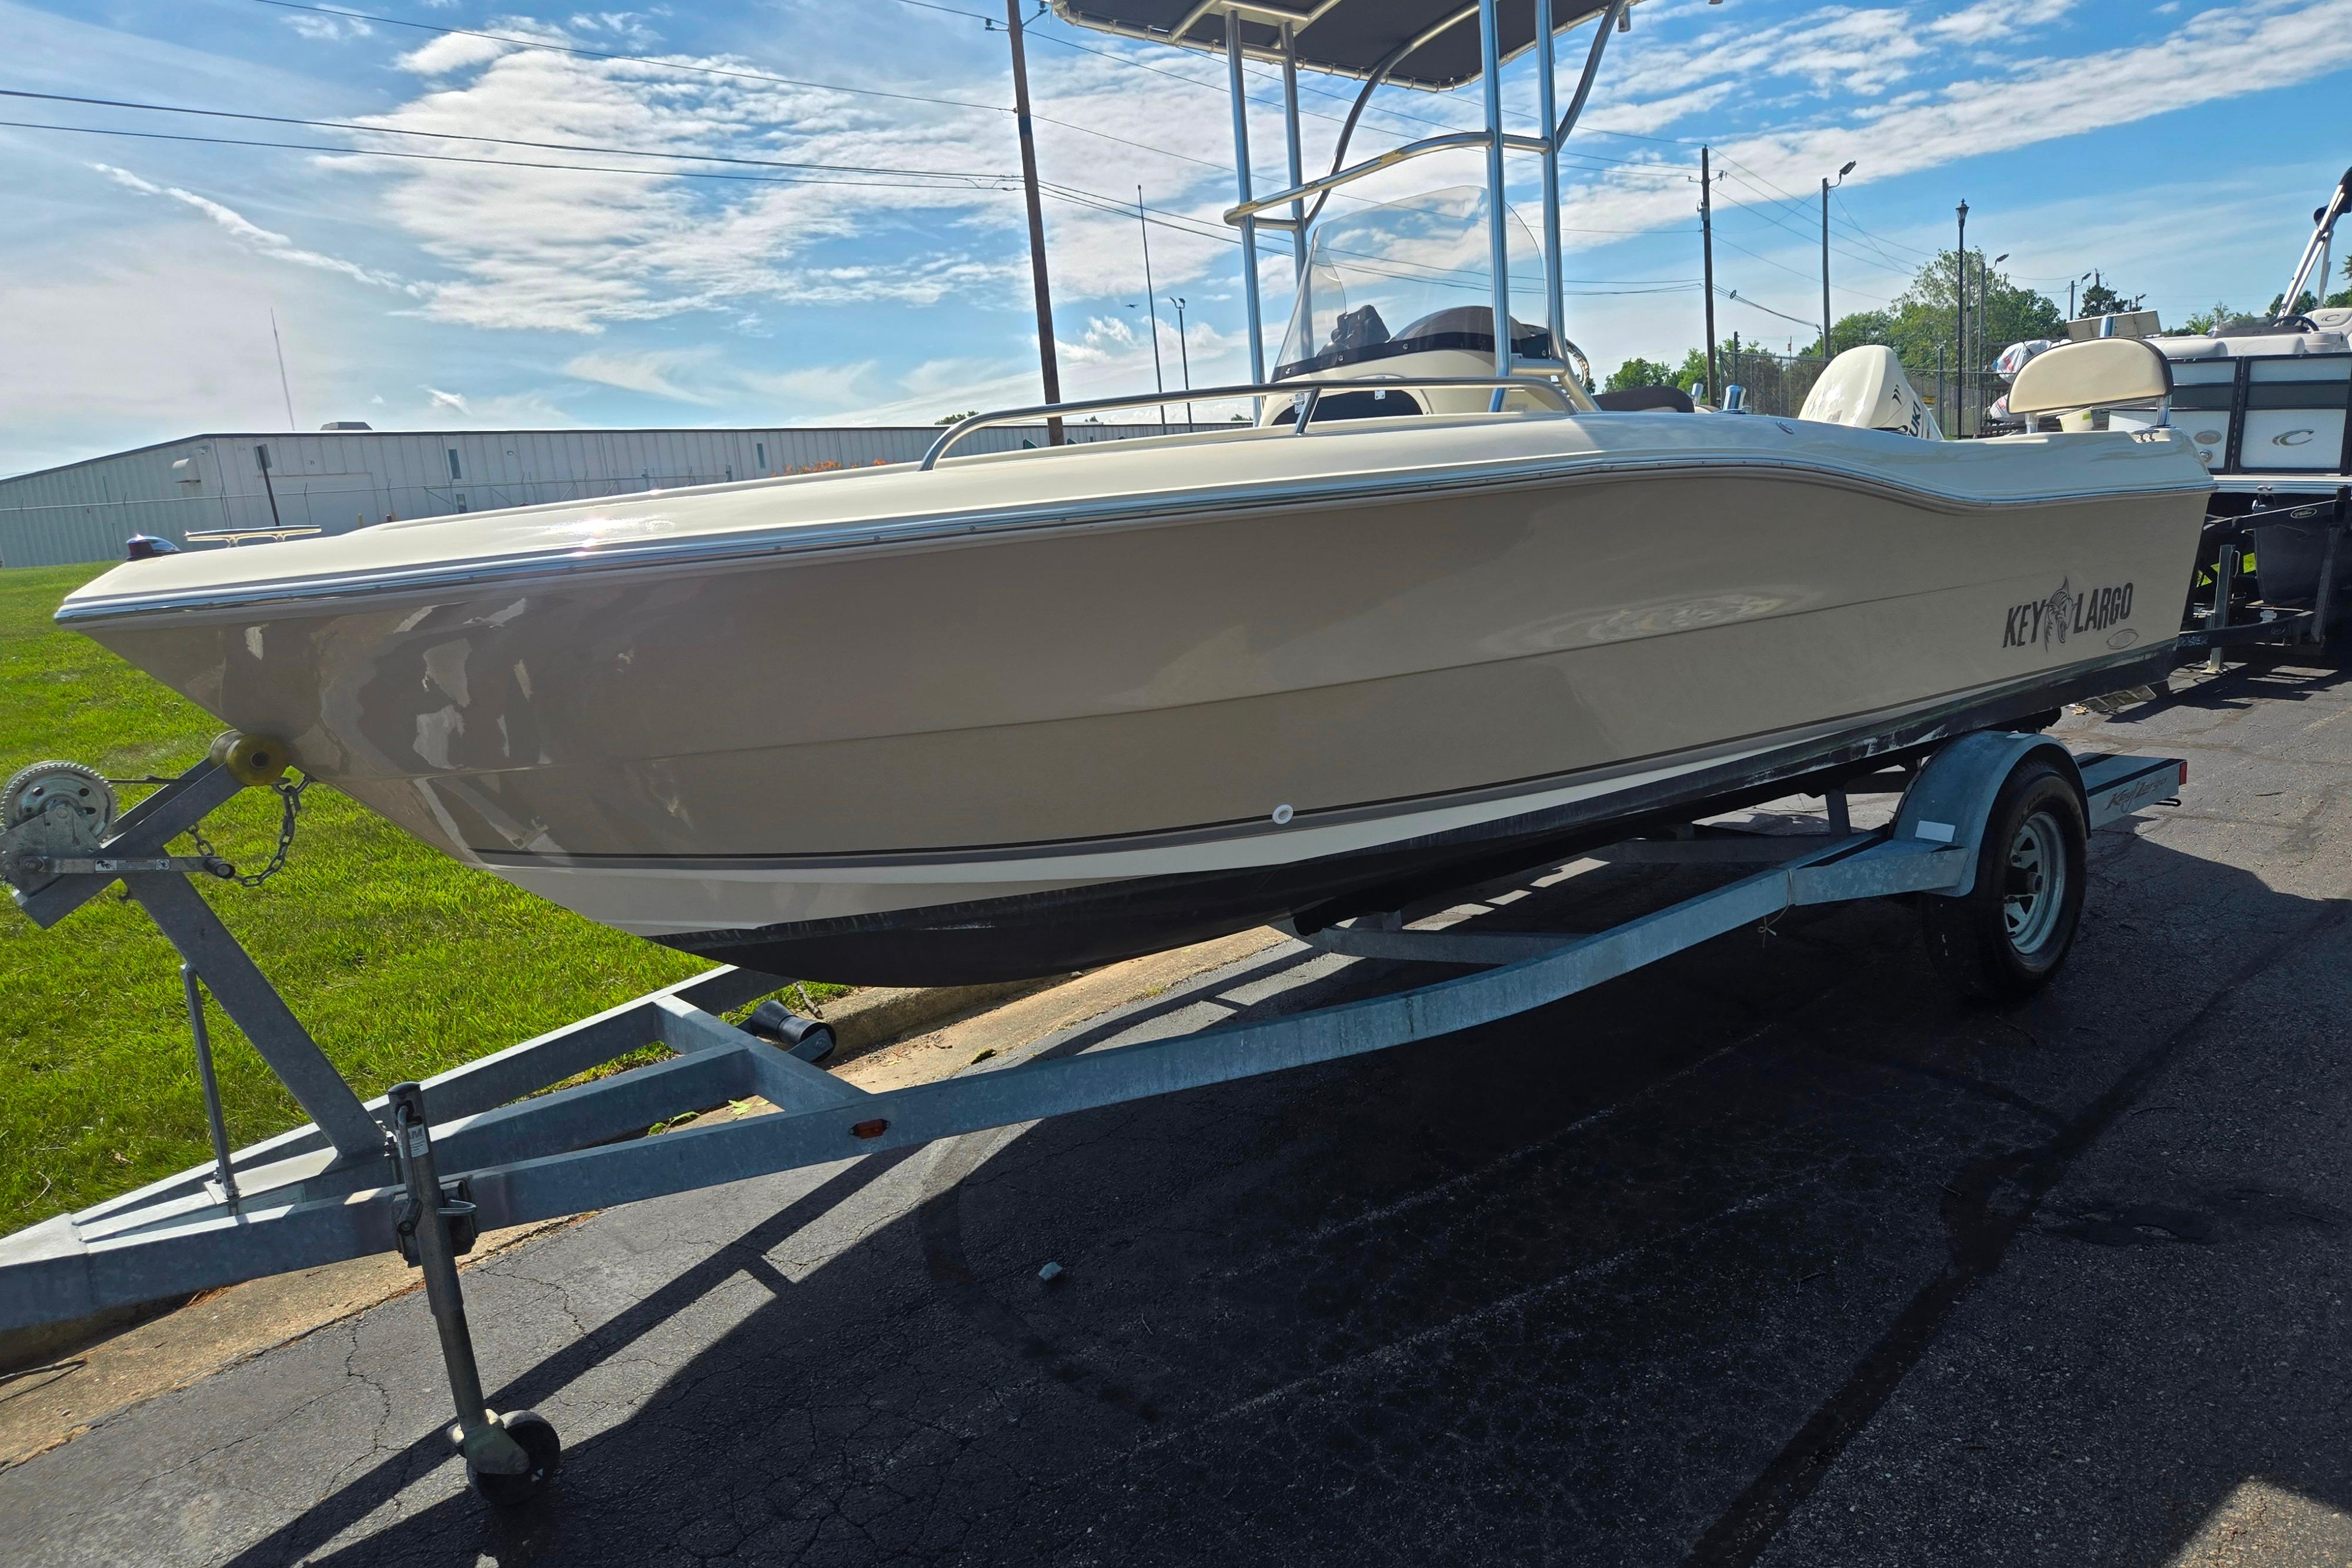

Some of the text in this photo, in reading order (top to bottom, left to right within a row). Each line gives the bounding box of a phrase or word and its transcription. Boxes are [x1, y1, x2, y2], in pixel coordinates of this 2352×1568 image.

[1908, 400, 1921, 437] UKI
[2002, 582, 2134, 648] KEY LARGO
[2104, 777, 2167, 813] Key Largo
